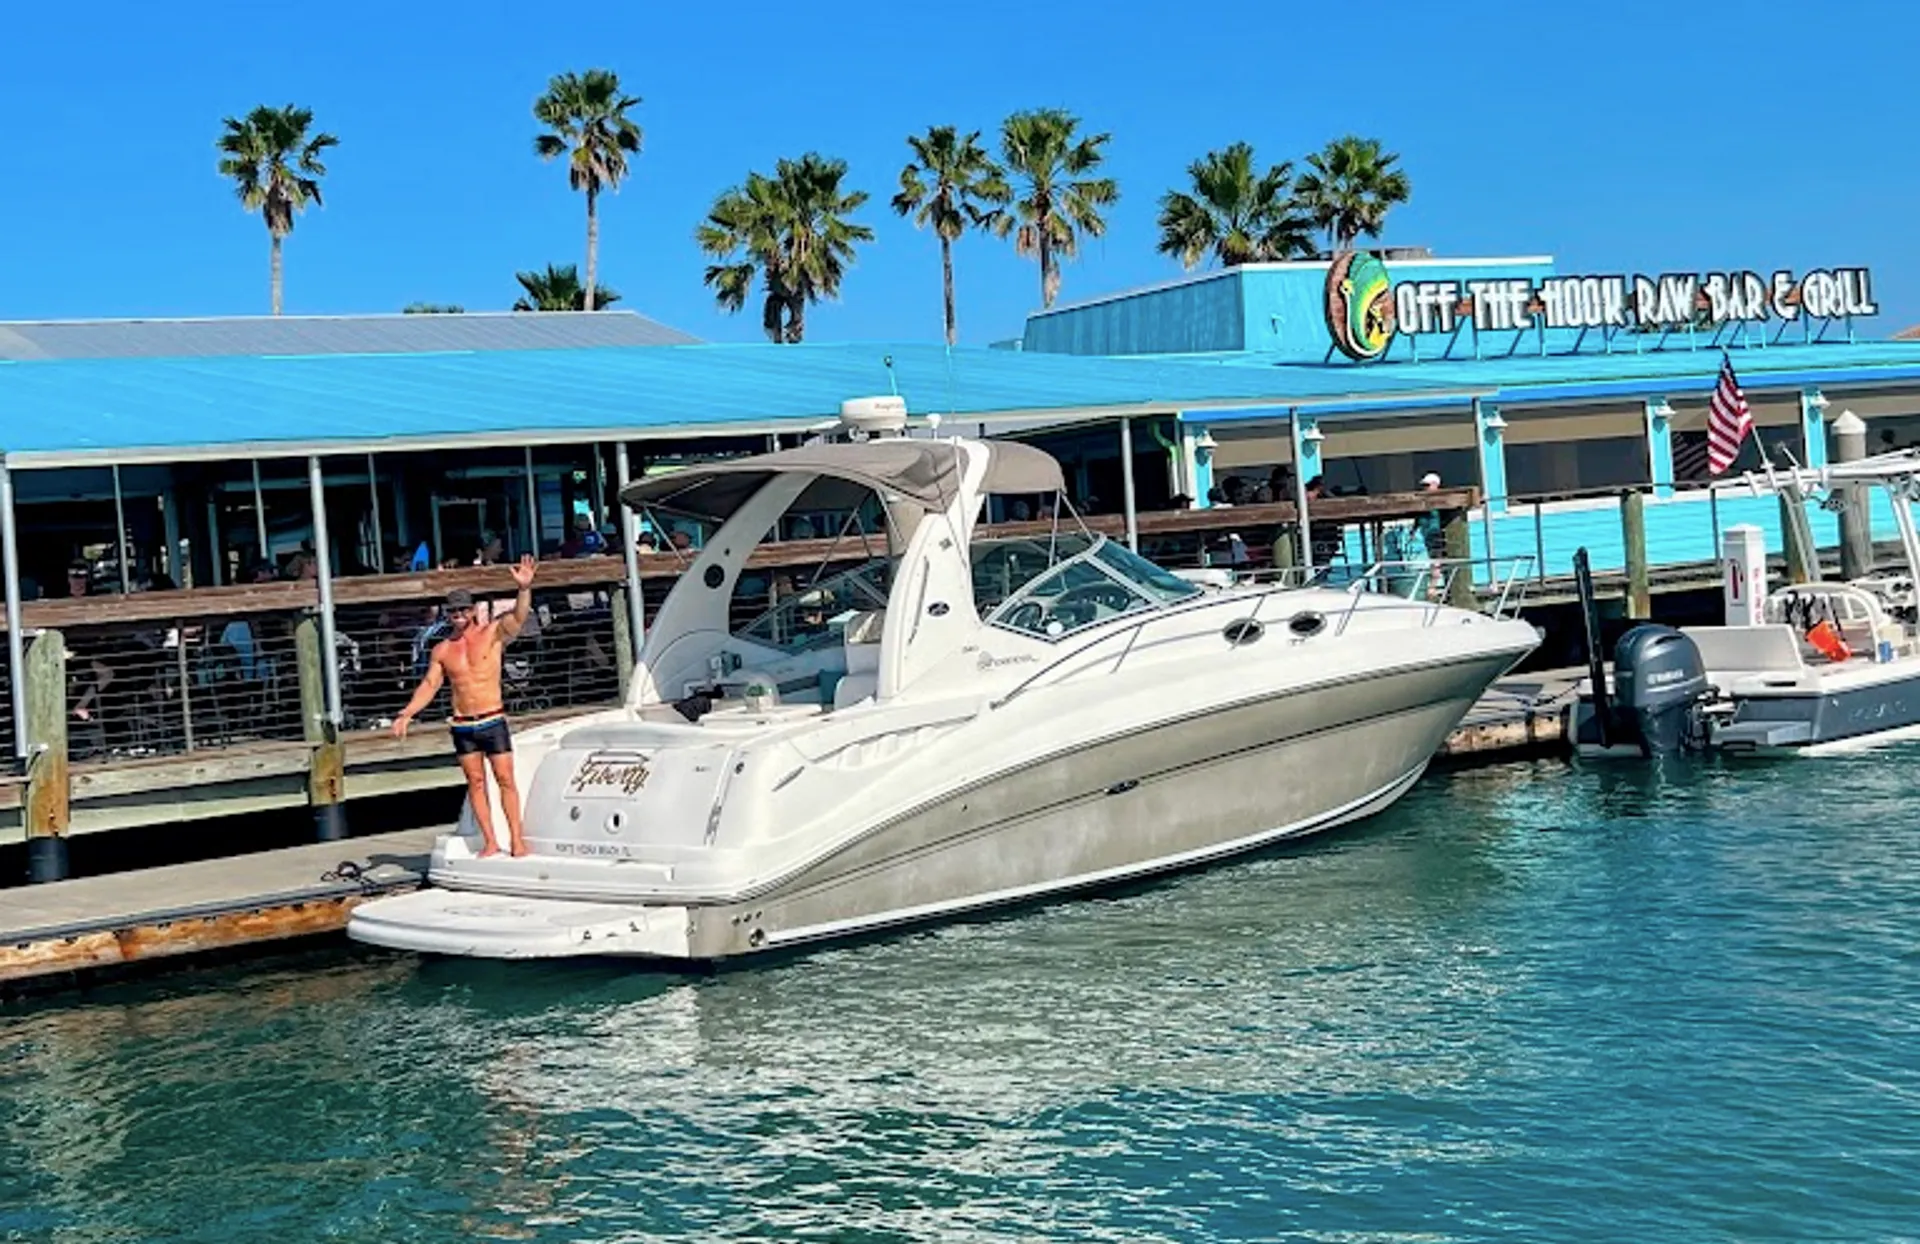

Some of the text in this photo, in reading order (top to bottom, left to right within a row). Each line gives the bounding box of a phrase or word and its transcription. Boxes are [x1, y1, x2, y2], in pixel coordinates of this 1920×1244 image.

[1395, 268, 1876, 335] OFF THE HOOK RAW BAR & GRILL
[570, 752, 650, 795] Liberty
